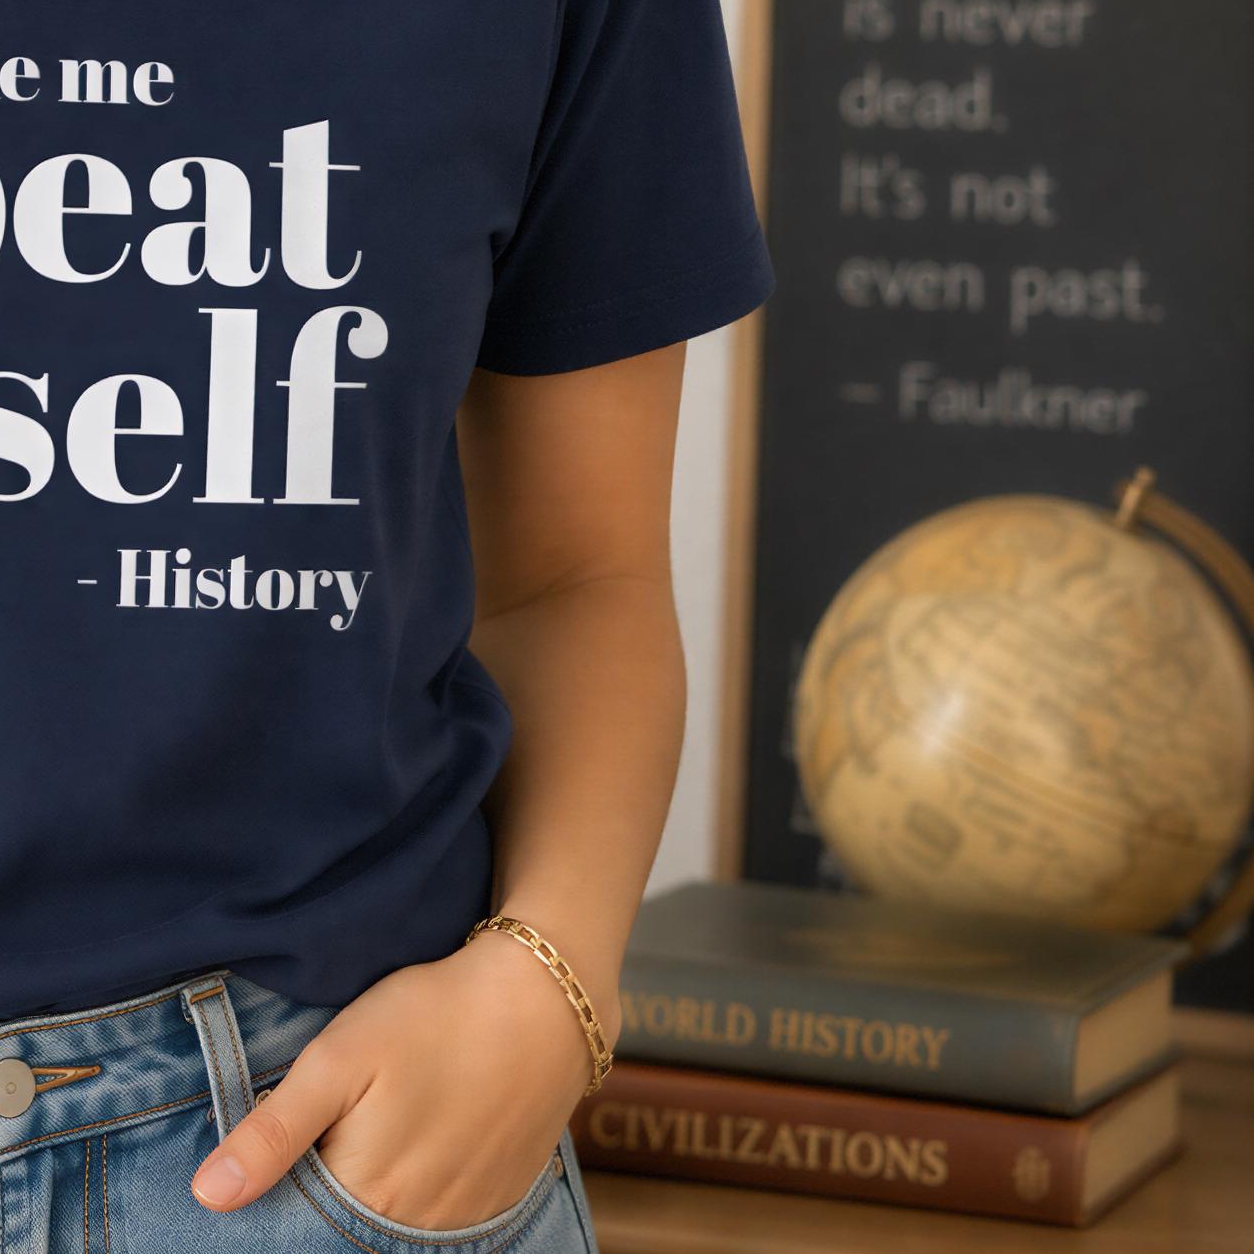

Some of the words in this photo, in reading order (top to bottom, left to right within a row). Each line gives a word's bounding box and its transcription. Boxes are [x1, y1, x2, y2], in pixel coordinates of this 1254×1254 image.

[58, 60, 173, 107] me
[838, 59, 1008, 132] dead.
[840, 151, 928, 221] It's
[950, 164, 1059, 228] not
[836, 255, 985, 312] even
[1010, 256, 1165, 335] past.
[899, 359, 1147, 434] Faulkner
[116, 548, 372, 631] History
[769, 1005, 950, 1069] HISTORY
[590, 1100, 949, 1186] CIVILIZATIONS
